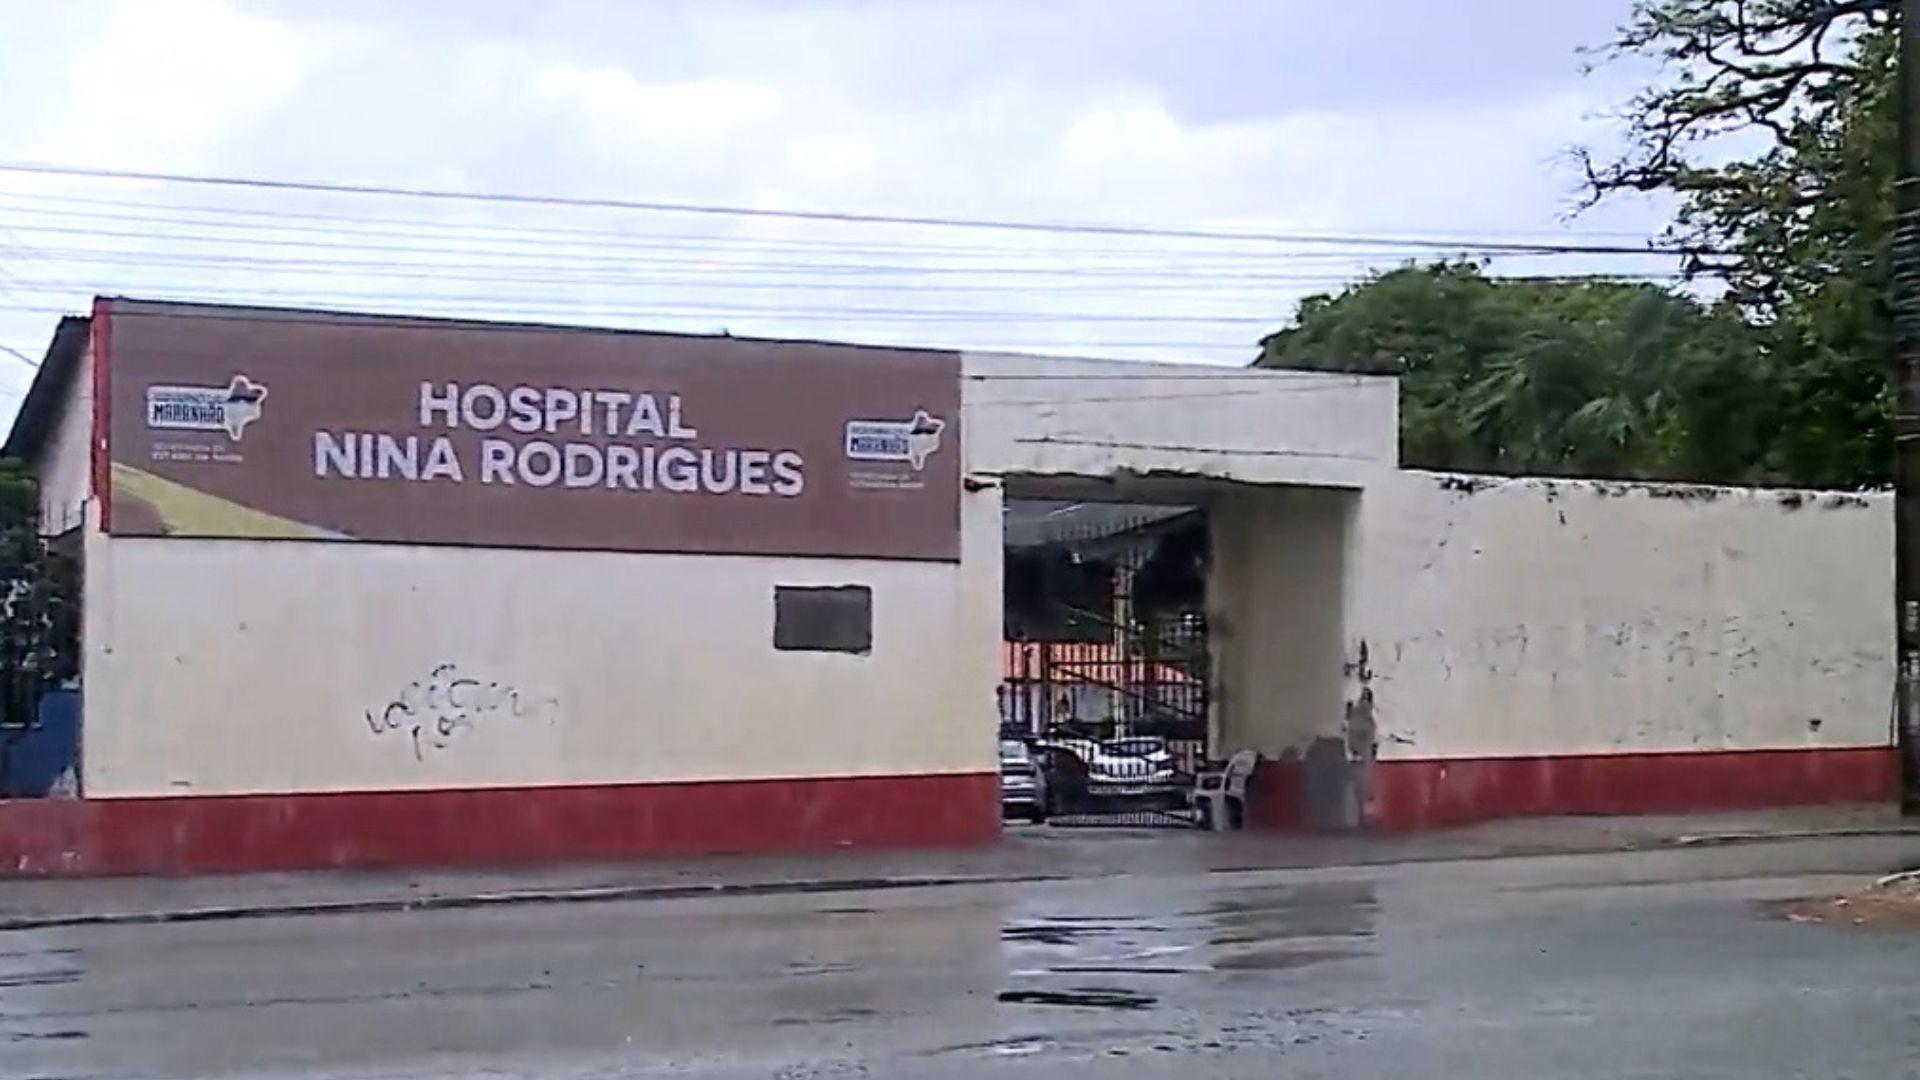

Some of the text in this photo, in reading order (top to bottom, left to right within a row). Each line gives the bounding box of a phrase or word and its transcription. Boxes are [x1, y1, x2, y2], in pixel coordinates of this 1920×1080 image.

[420, 381, 697, 439] HOSPITAL
[314, 430, 804, 496] NINA RODRIGUES
